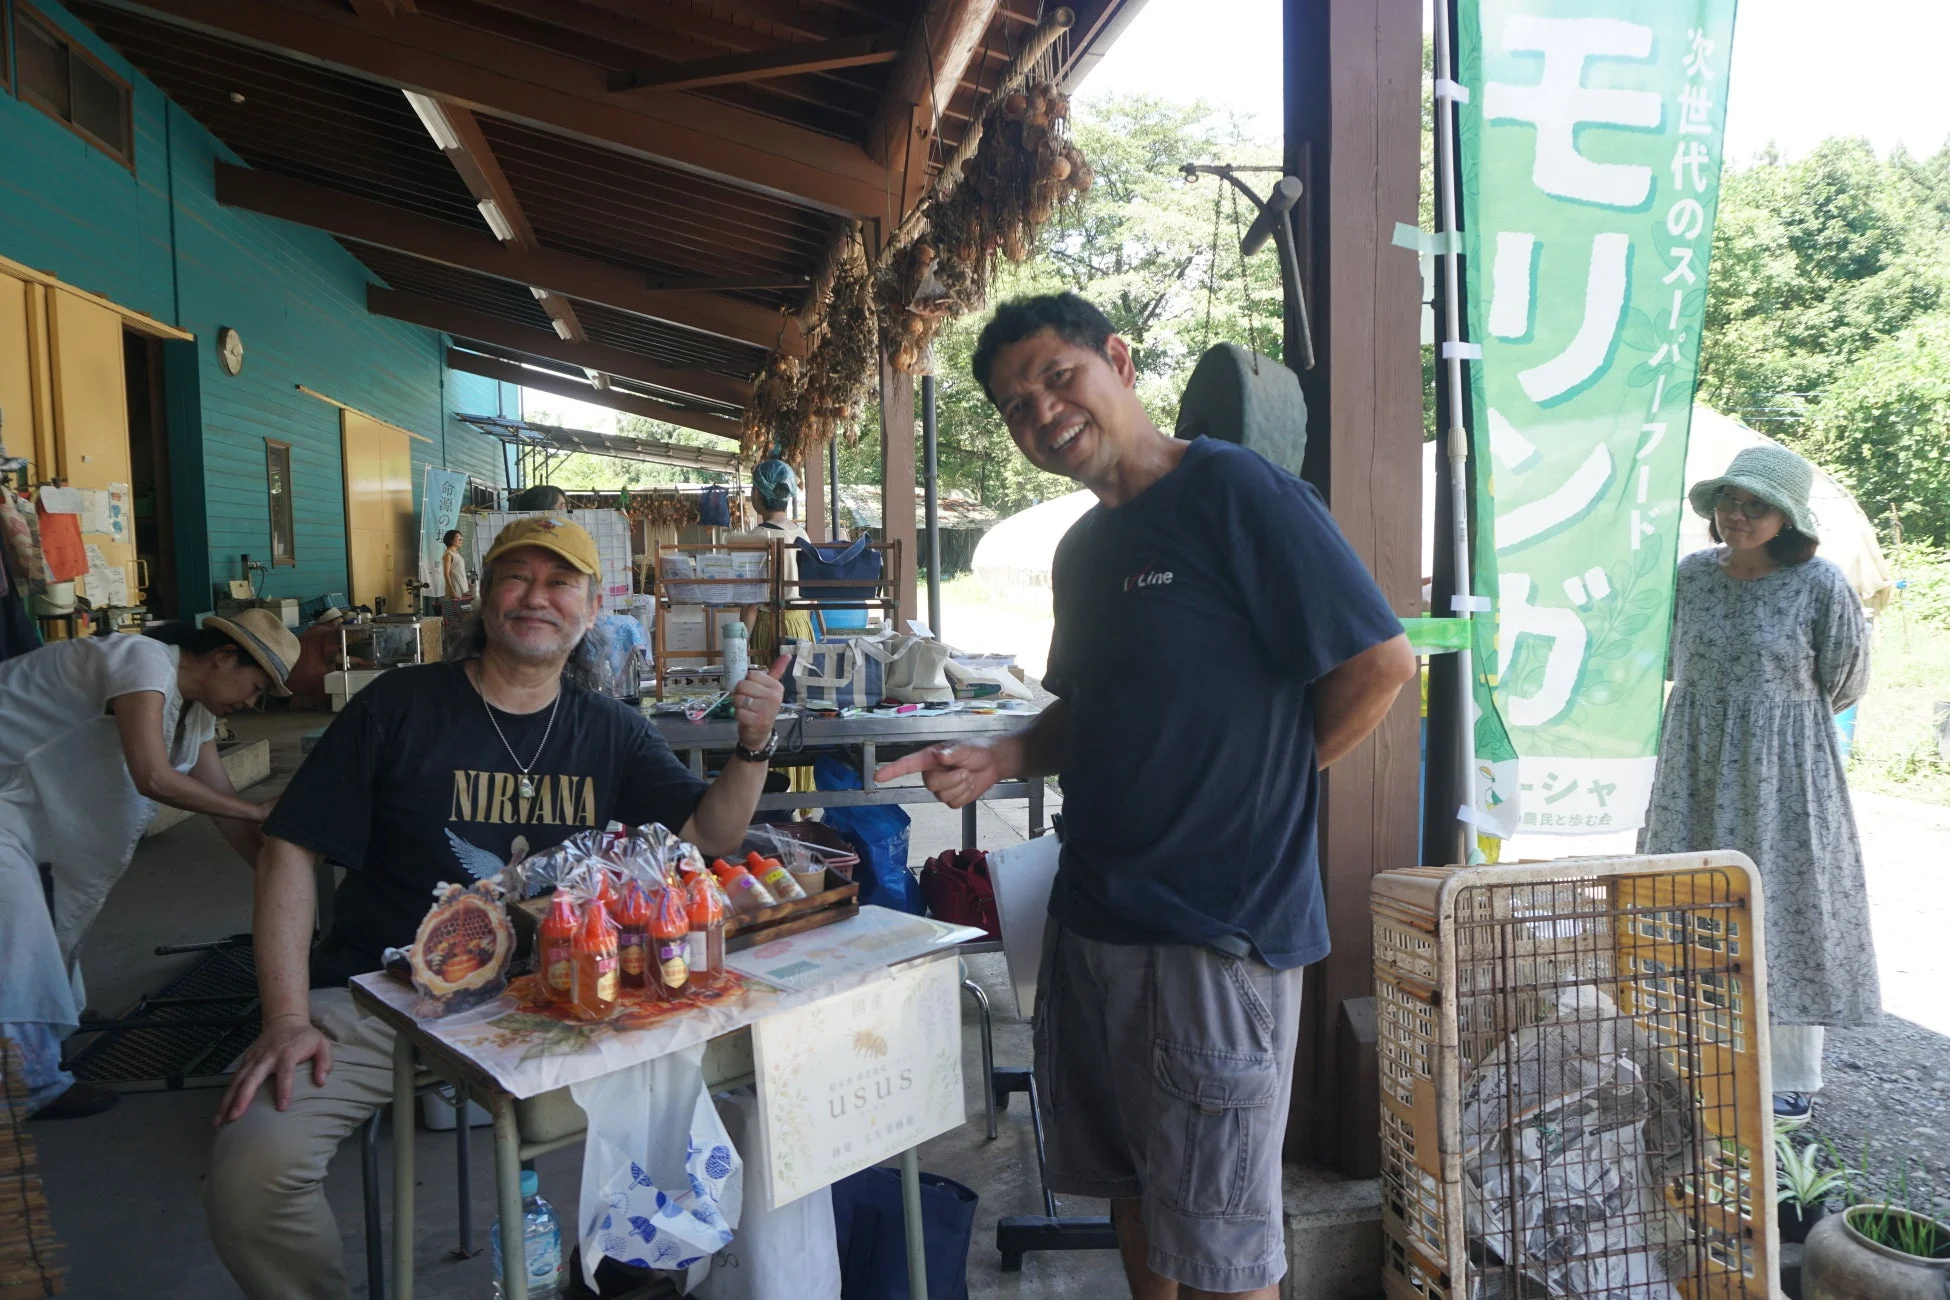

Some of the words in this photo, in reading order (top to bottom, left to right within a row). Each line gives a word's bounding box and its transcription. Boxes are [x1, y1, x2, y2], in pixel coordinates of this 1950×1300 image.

[1482, 14, 1666, 730] モリンガ
[1629, 26, 1718, 551] 次世代のスーパーフード
[448, 769, 597, 828] NIRVANA
[1518, 812, 1613, 828] 農民と歩む会
